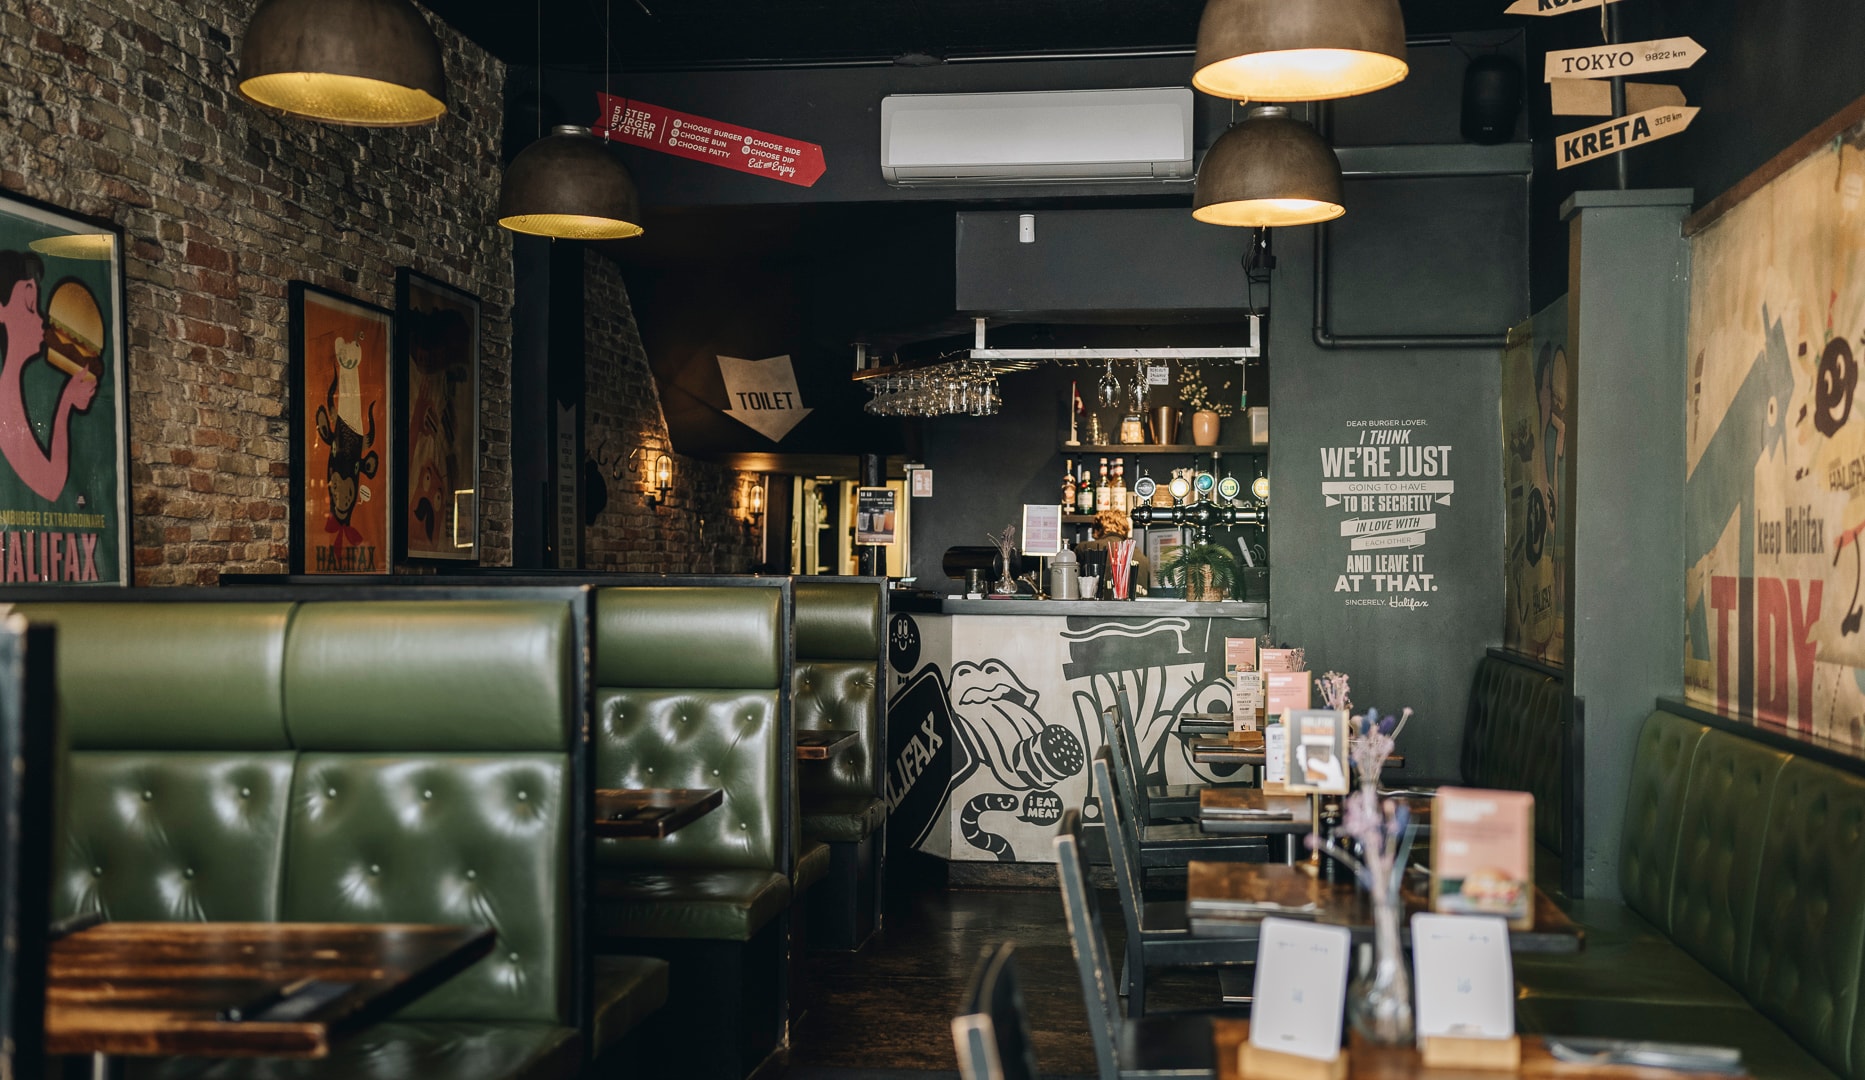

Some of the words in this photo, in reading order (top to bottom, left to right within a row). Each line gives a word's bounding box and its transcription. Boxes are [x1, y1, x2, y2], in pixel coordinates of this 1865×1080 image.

[1562, 52, 1634, 73] TOKYO
[1645, 51, 1671, 61] 9822
[614, 105, 621, 115] 5
[625, 108, 651, 120] STEP
[611, 122, 653, 140] SYSTEM
[612, 114, 656, 132] BURGER
[680, 131, 710, 144] CHOOSE
[711, 138, 727, 148] BUN
[682, 122, 712, 135] CHOOSE
[713, 129, 743, 142] BURGER
[1564, 116, 1651, 162] KRETA
[1672, 113, 1682, 121] km
[677, 140, 707, 153] CHOOSE
[708, 148, 731, 158] PATTY
[750, 148, 781, 161] CHOOSE
[753, 139, 783, 152] CHOOSE
[784, 147, 801, 156] SIDE
[748, 157, 763, 169] Eat
[771, 161, 796, 178] Enjoy
[736, 392, 793, 410] TOILET
[1368, 419, 1400, 427] BURGER
[1359, 430, 1366, 445] I
[1370, 429, 1412, 445] THINK
[1320, 447, 1390, 478] WE'RE
[1396, 445, 1452, 477] JUST
[1348, 483, 1381, 492] GOING
[1385, 483, 1398, 491] TO
[1400, 483, 1427, 491] HAVE
[1343, 496, 1357, 512] TO
[1361, 495, 1374, 512] BE
[1378, 495, 1432, 512] SECRETLY
[1356, 522, 1367, 533] IN
[1369, 519, 1393, 532] LOVE
[1395, 517, 1420, 529] WITH
[1757, 509, 1781, 563] keep
[1785, 504, 1824, 554] Halifax
[1365, 539, 1385, 547] EACH
[1386, 537, 1412, 545] OTHER
[1346, 554, 1371, 573] AND
[1375, 554, 1409, 573] LEAVE
[1412, 554, 1424, 572] IT
[1334, 575, 1364, 592] AT
[1371, 574, 1438, 592] THAT.
[1389, 595, 1429, 611] Halifax
[1711, 576, 1823, 738] TIDY
[1036, 797, 1058, 807] EAT
[1027, 807, 1060, 818] MEAT
